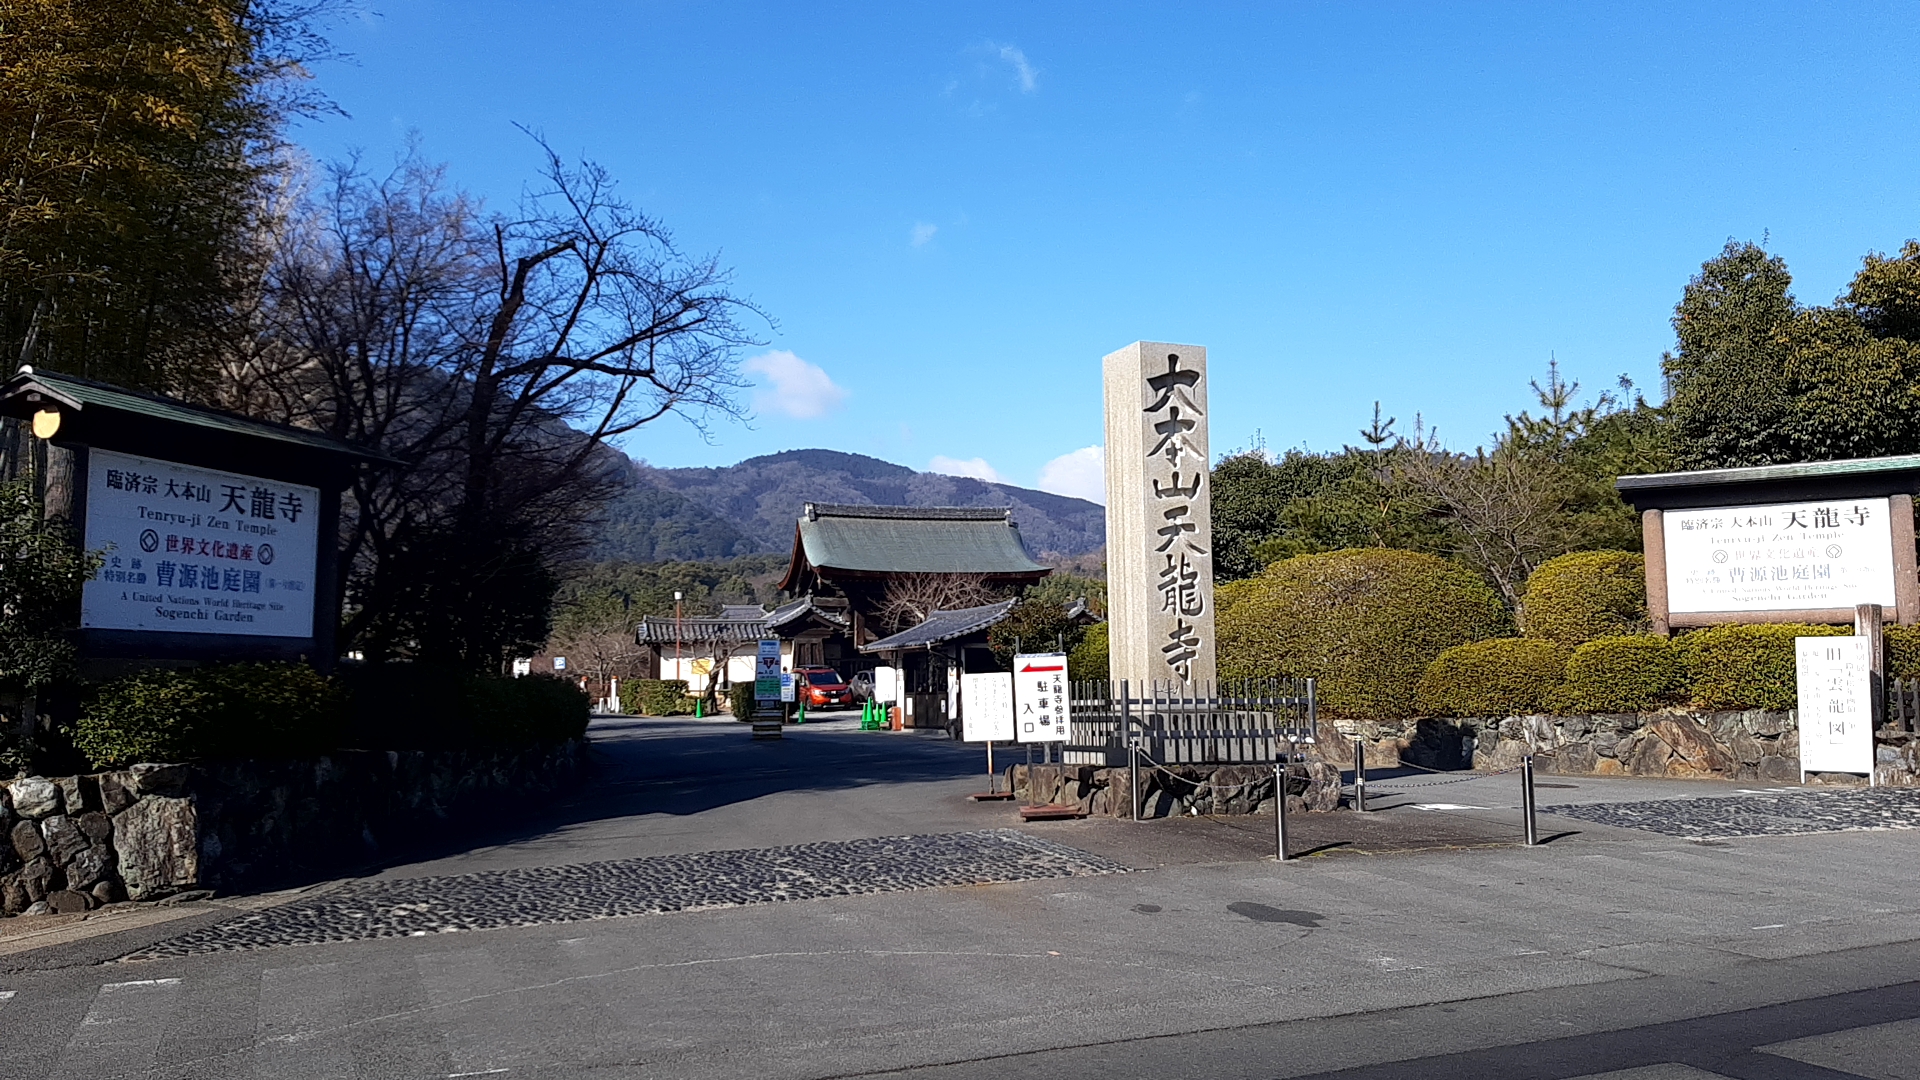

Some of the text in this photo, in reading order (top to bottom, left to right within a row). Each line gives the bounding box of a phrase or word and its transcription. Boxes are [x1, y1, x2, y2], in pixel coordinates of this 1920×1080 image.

[106, 469, 303, 523] 臨済宗 大本山 天龍寺
[138, 506, 278, 536] Tenryu-ji Zen Temple
[1143, 354, 1208, 684] 大本山天龍寺
[1680, 505, 1870, 531] 臨済宗 大本山 天龍寺
[165, 535, 254, 561] 世界文化遺産
[121, 592, 128, 601] A
[132, 592, 162, 603] United
[167, 595, 200, 606] Nations
[204, 597, 229, 608] World
[232, 599, 266, 611] Heritage
[155, 606, 254, 623] Sogenchi Garden
[1023, 703, 1034, 733] 入口
[1037, 681, 1050, 726] 駐車場
